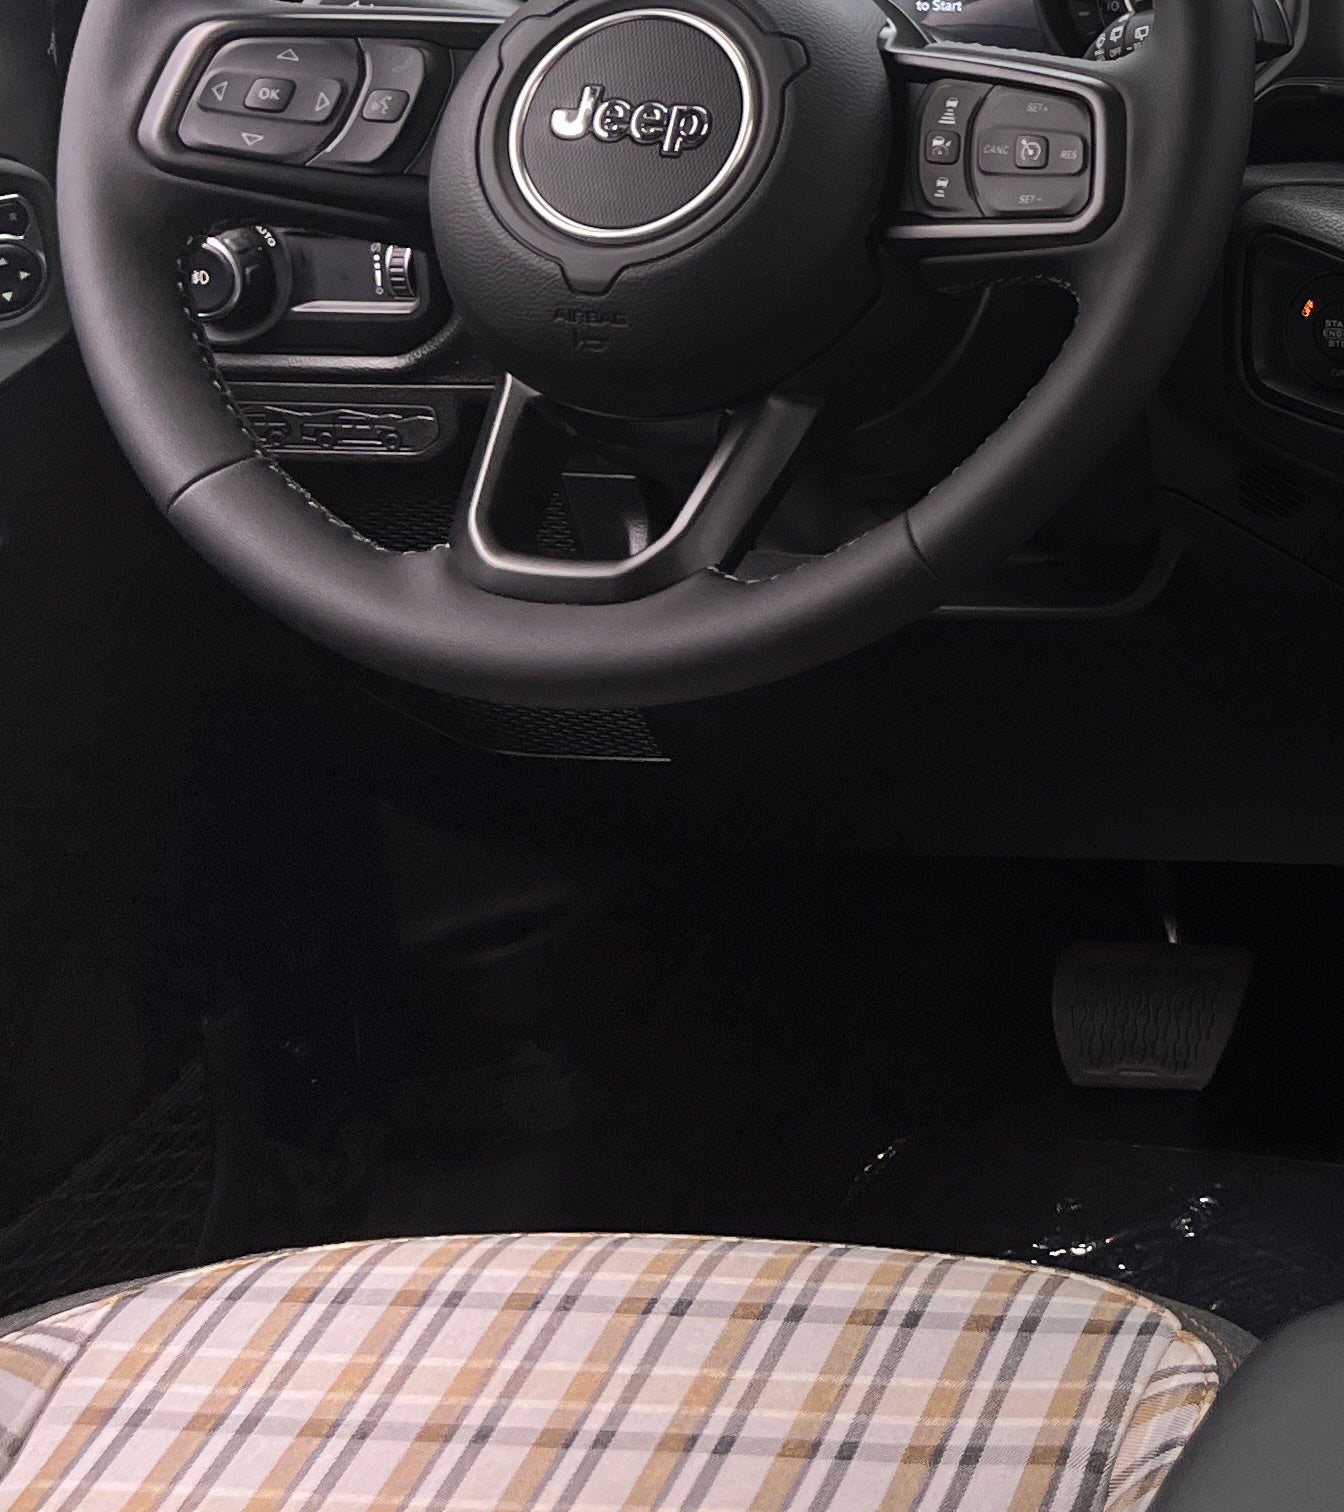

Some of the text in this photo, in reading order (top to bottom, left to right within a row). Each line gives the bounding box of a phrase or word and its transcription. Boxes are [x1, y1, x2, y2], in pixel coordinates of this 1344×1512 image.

[915, 0, 962, 12] to Start
[1107, 2, 1120, 12] 10
[259, 88, 280, 100] OK
[549, 83, 714, 157] Jeep
[1060, 149, 1078, 160] RES
